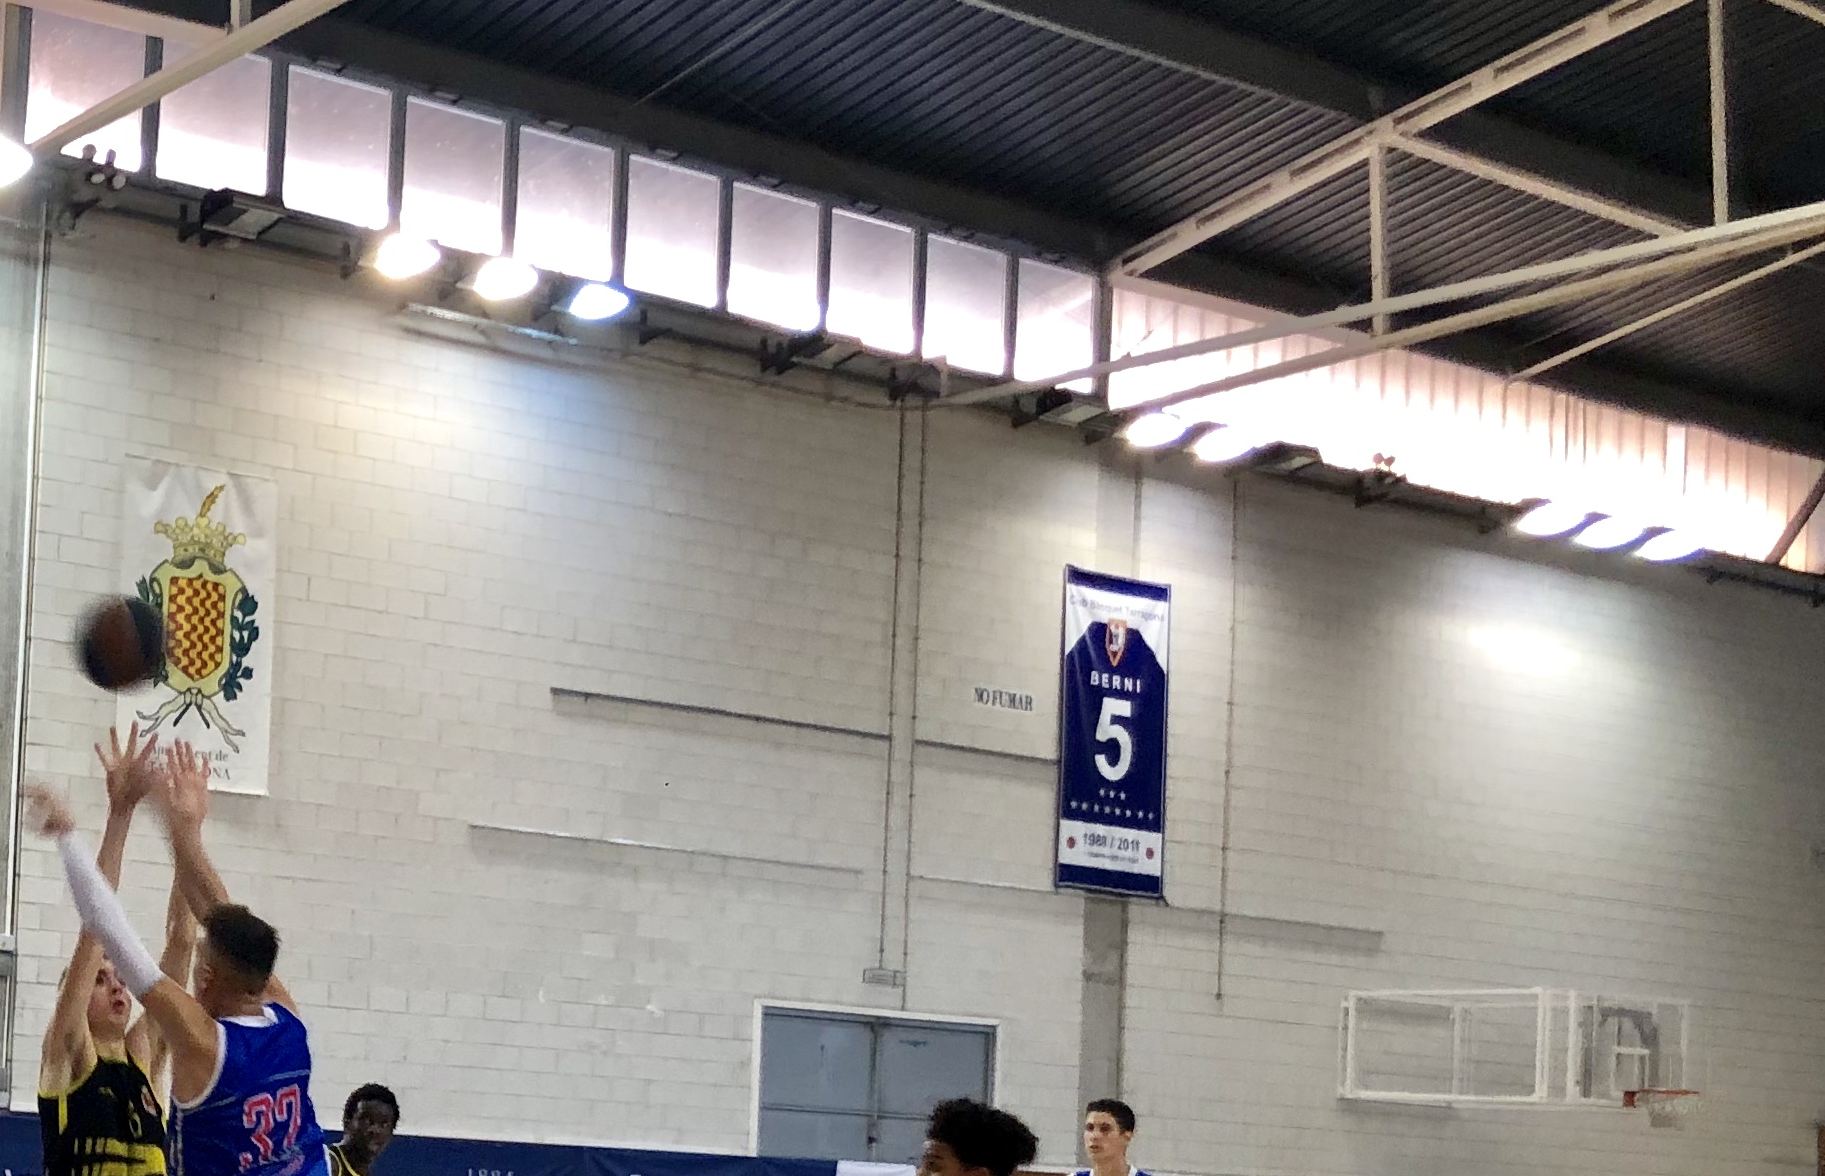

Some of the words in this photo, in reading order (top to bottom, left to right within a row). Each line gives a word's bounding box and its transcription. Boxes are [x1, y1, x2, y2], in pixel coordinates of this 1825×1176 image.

[1090, 670, 1141, 693] BERNI
[974, 687, 990, 705] NO
[992, 689, 1033, 711] FUMAR
[1094, 696, 1133, 781] 5
